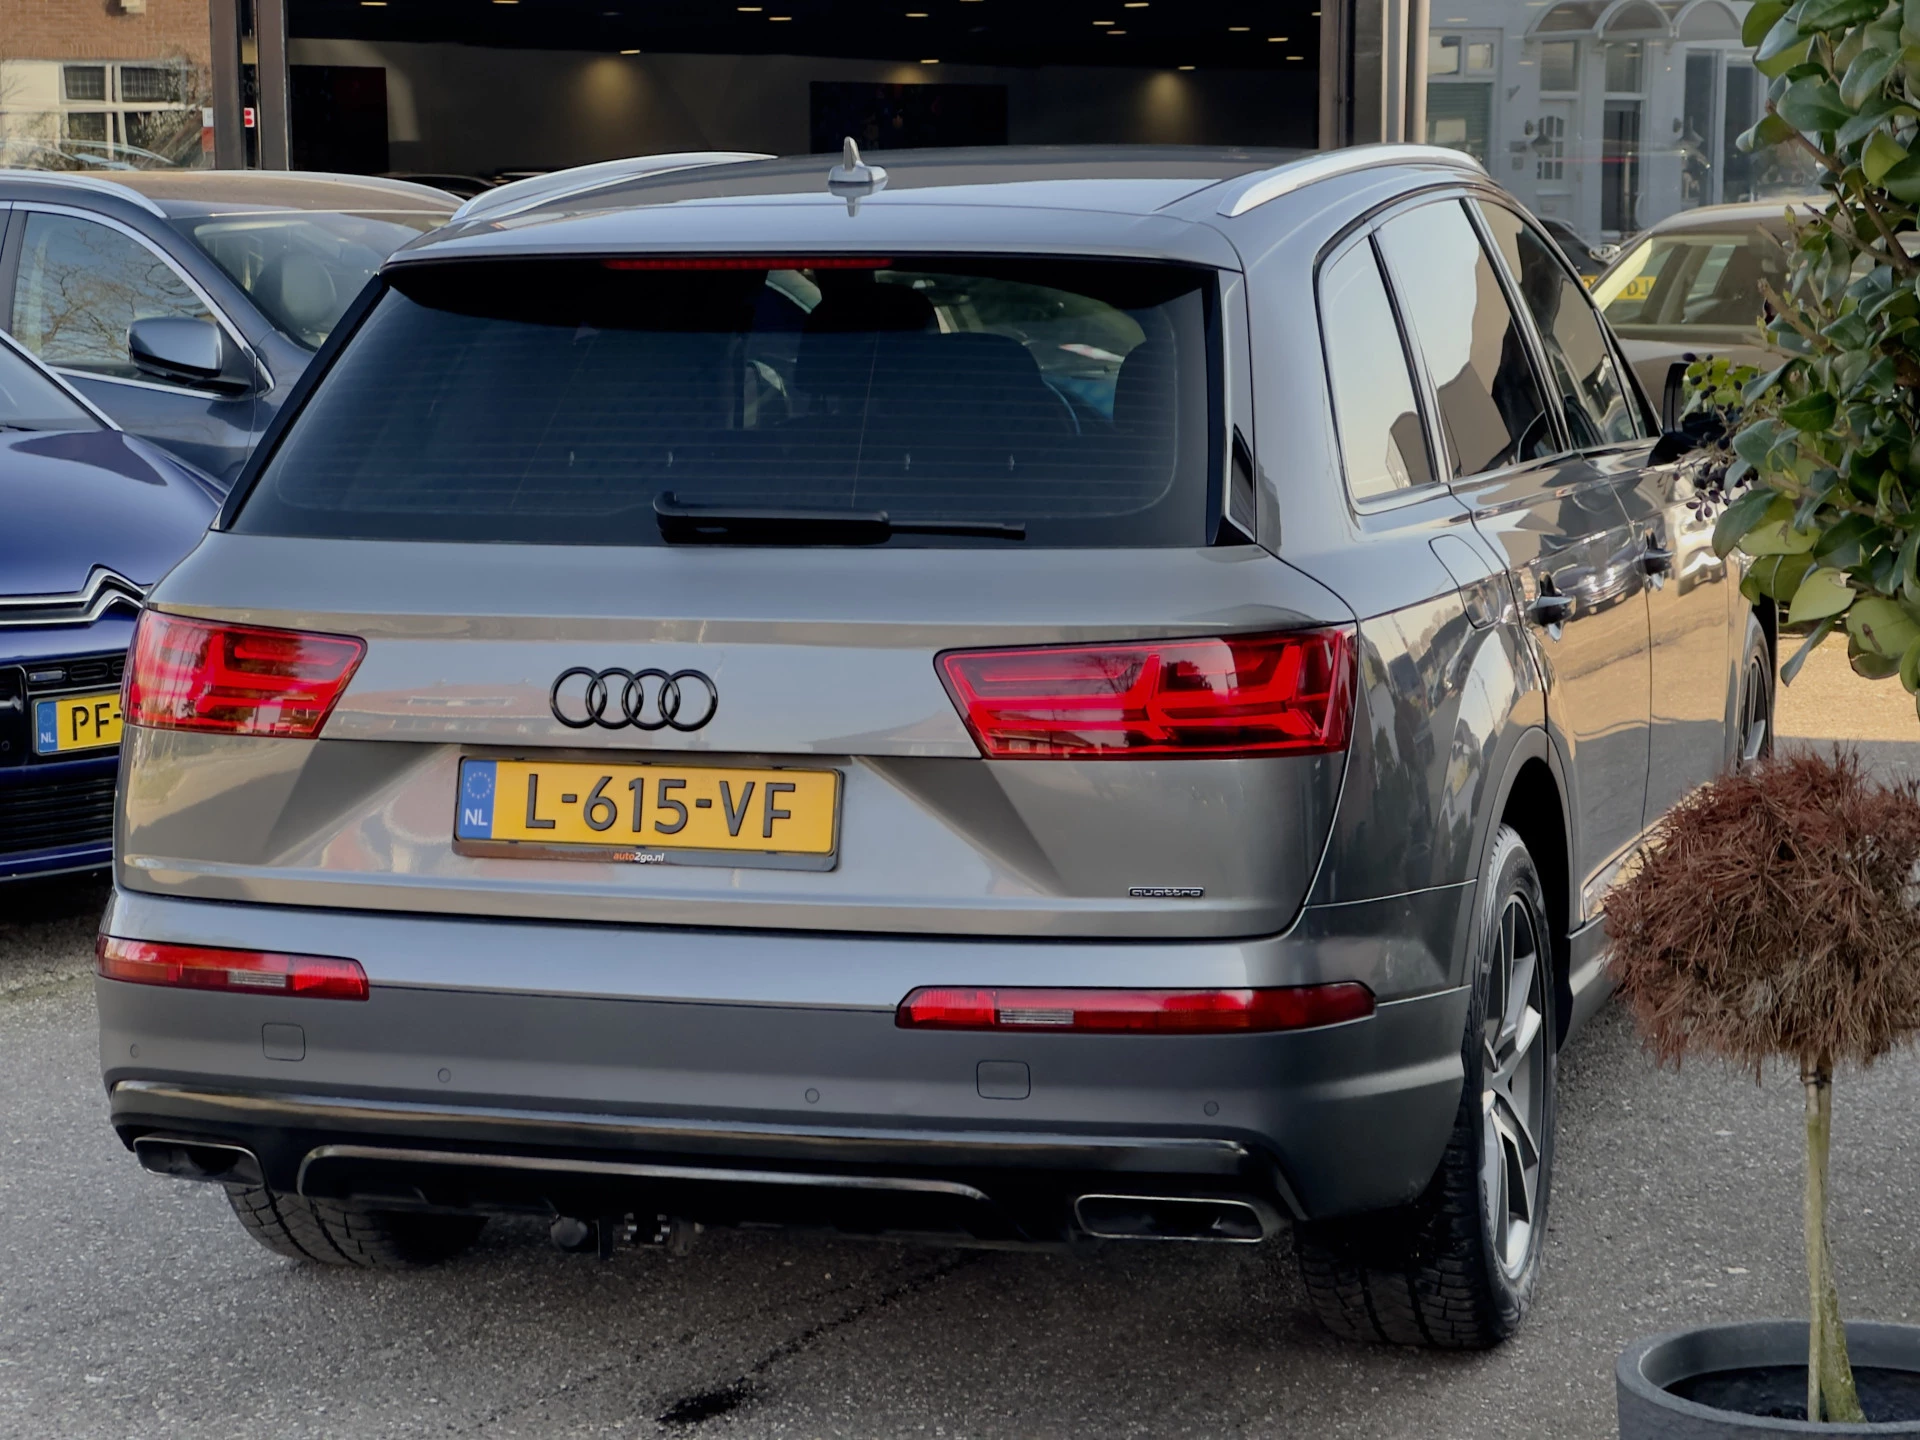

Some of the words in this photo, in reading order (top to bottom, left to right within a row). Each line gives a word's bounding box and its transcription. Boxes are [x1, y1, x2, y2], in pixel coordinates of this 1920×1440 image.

[40, 731, 55, 744] NL
[525, 773, 796, 838] L-615-VF
[464, 807, 488, 826] NL
[613, 852, 664, 863] auto2go.nl
[1131, 888, 1202, 897] quattro
